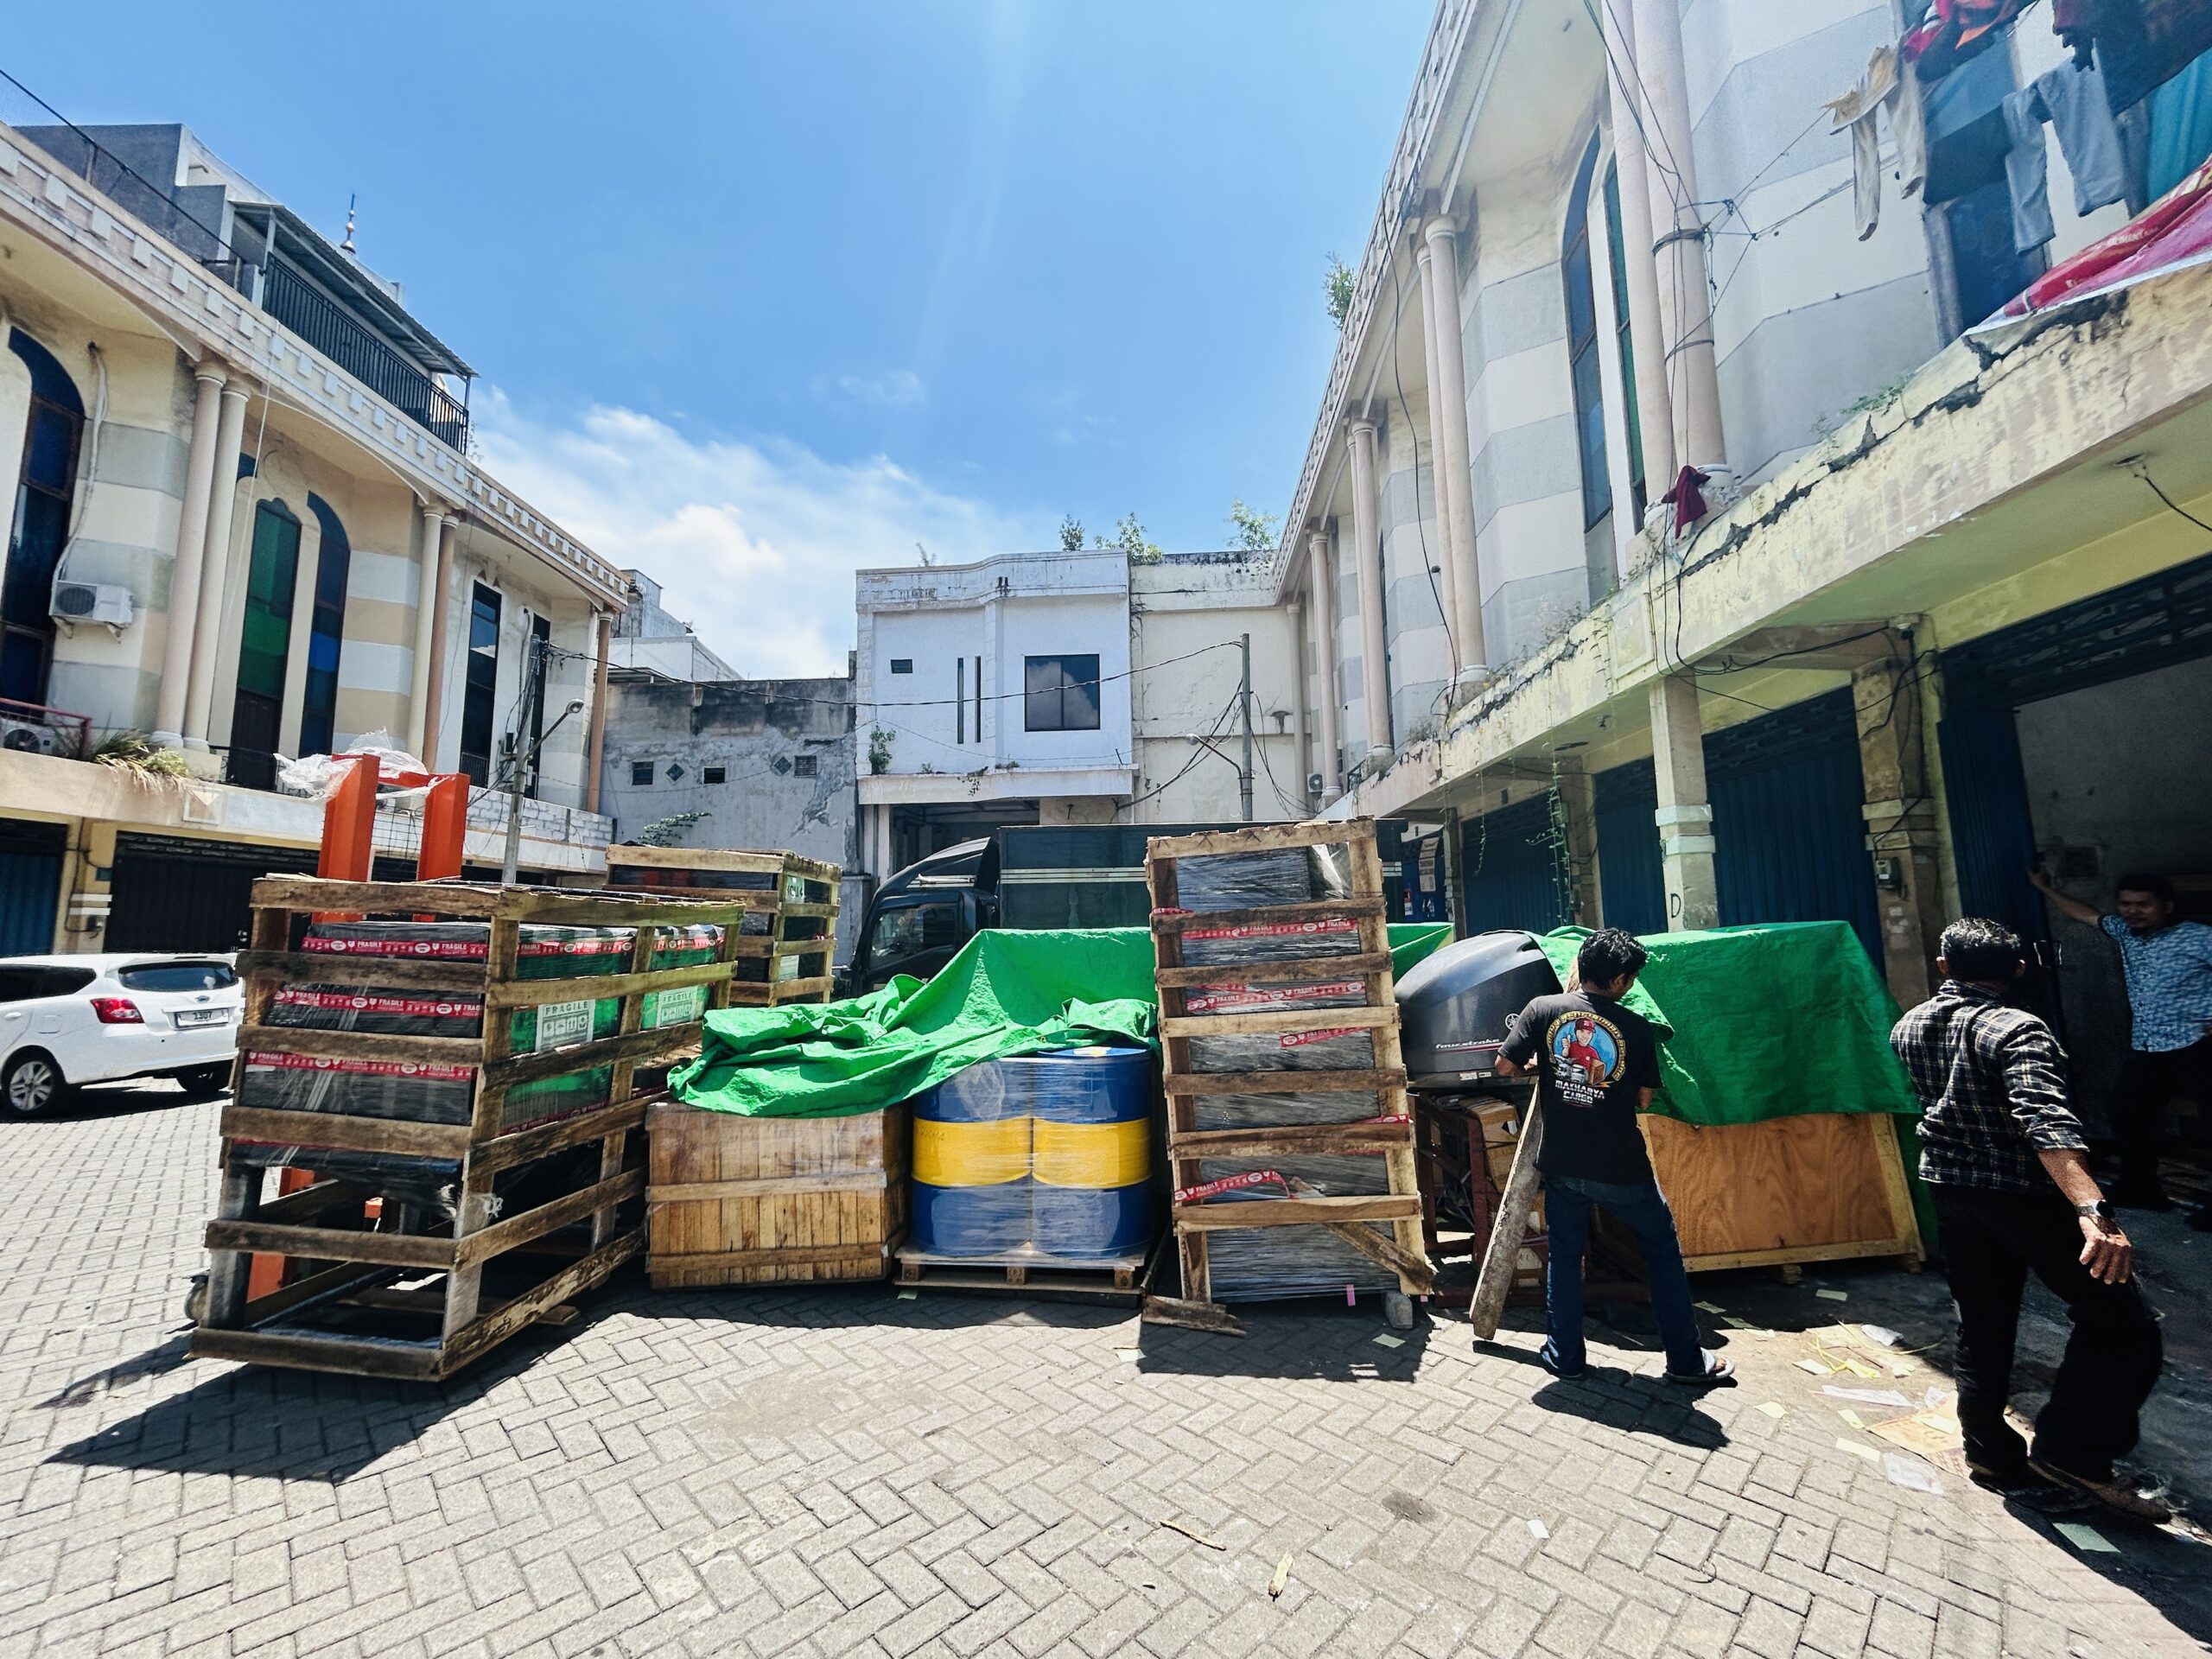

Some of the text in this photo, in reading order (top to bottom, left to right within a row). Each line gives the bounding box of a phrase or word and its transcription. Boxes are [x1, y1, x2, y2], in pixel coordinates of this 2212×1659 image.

[1670, 893, 1681, 918] D
[357, 940, 383, 949] FRAGILE
[1294, 987, 1318, 995] FRAGILE
[378, 999, 404, 1007] FRAGILE
[1216, 994, 1240, 1003] FRAGILE
[545, 1001, 588, 1015] FRAGILE
[1306, 1029, 1330, 1039] FRAGILE
[1435, 1039, 1500, 1049] fourstroke
[257, 1052, 283, 1061] FRAGILE
[429, 1065, 454, 1073] FRAGILE
[1555, 1079, 1605, 1099] MAKHARYA
[1562, 1090, 1593, 1103] CARGO
[1196, 1181, 1219, 1192] FRAGILE
